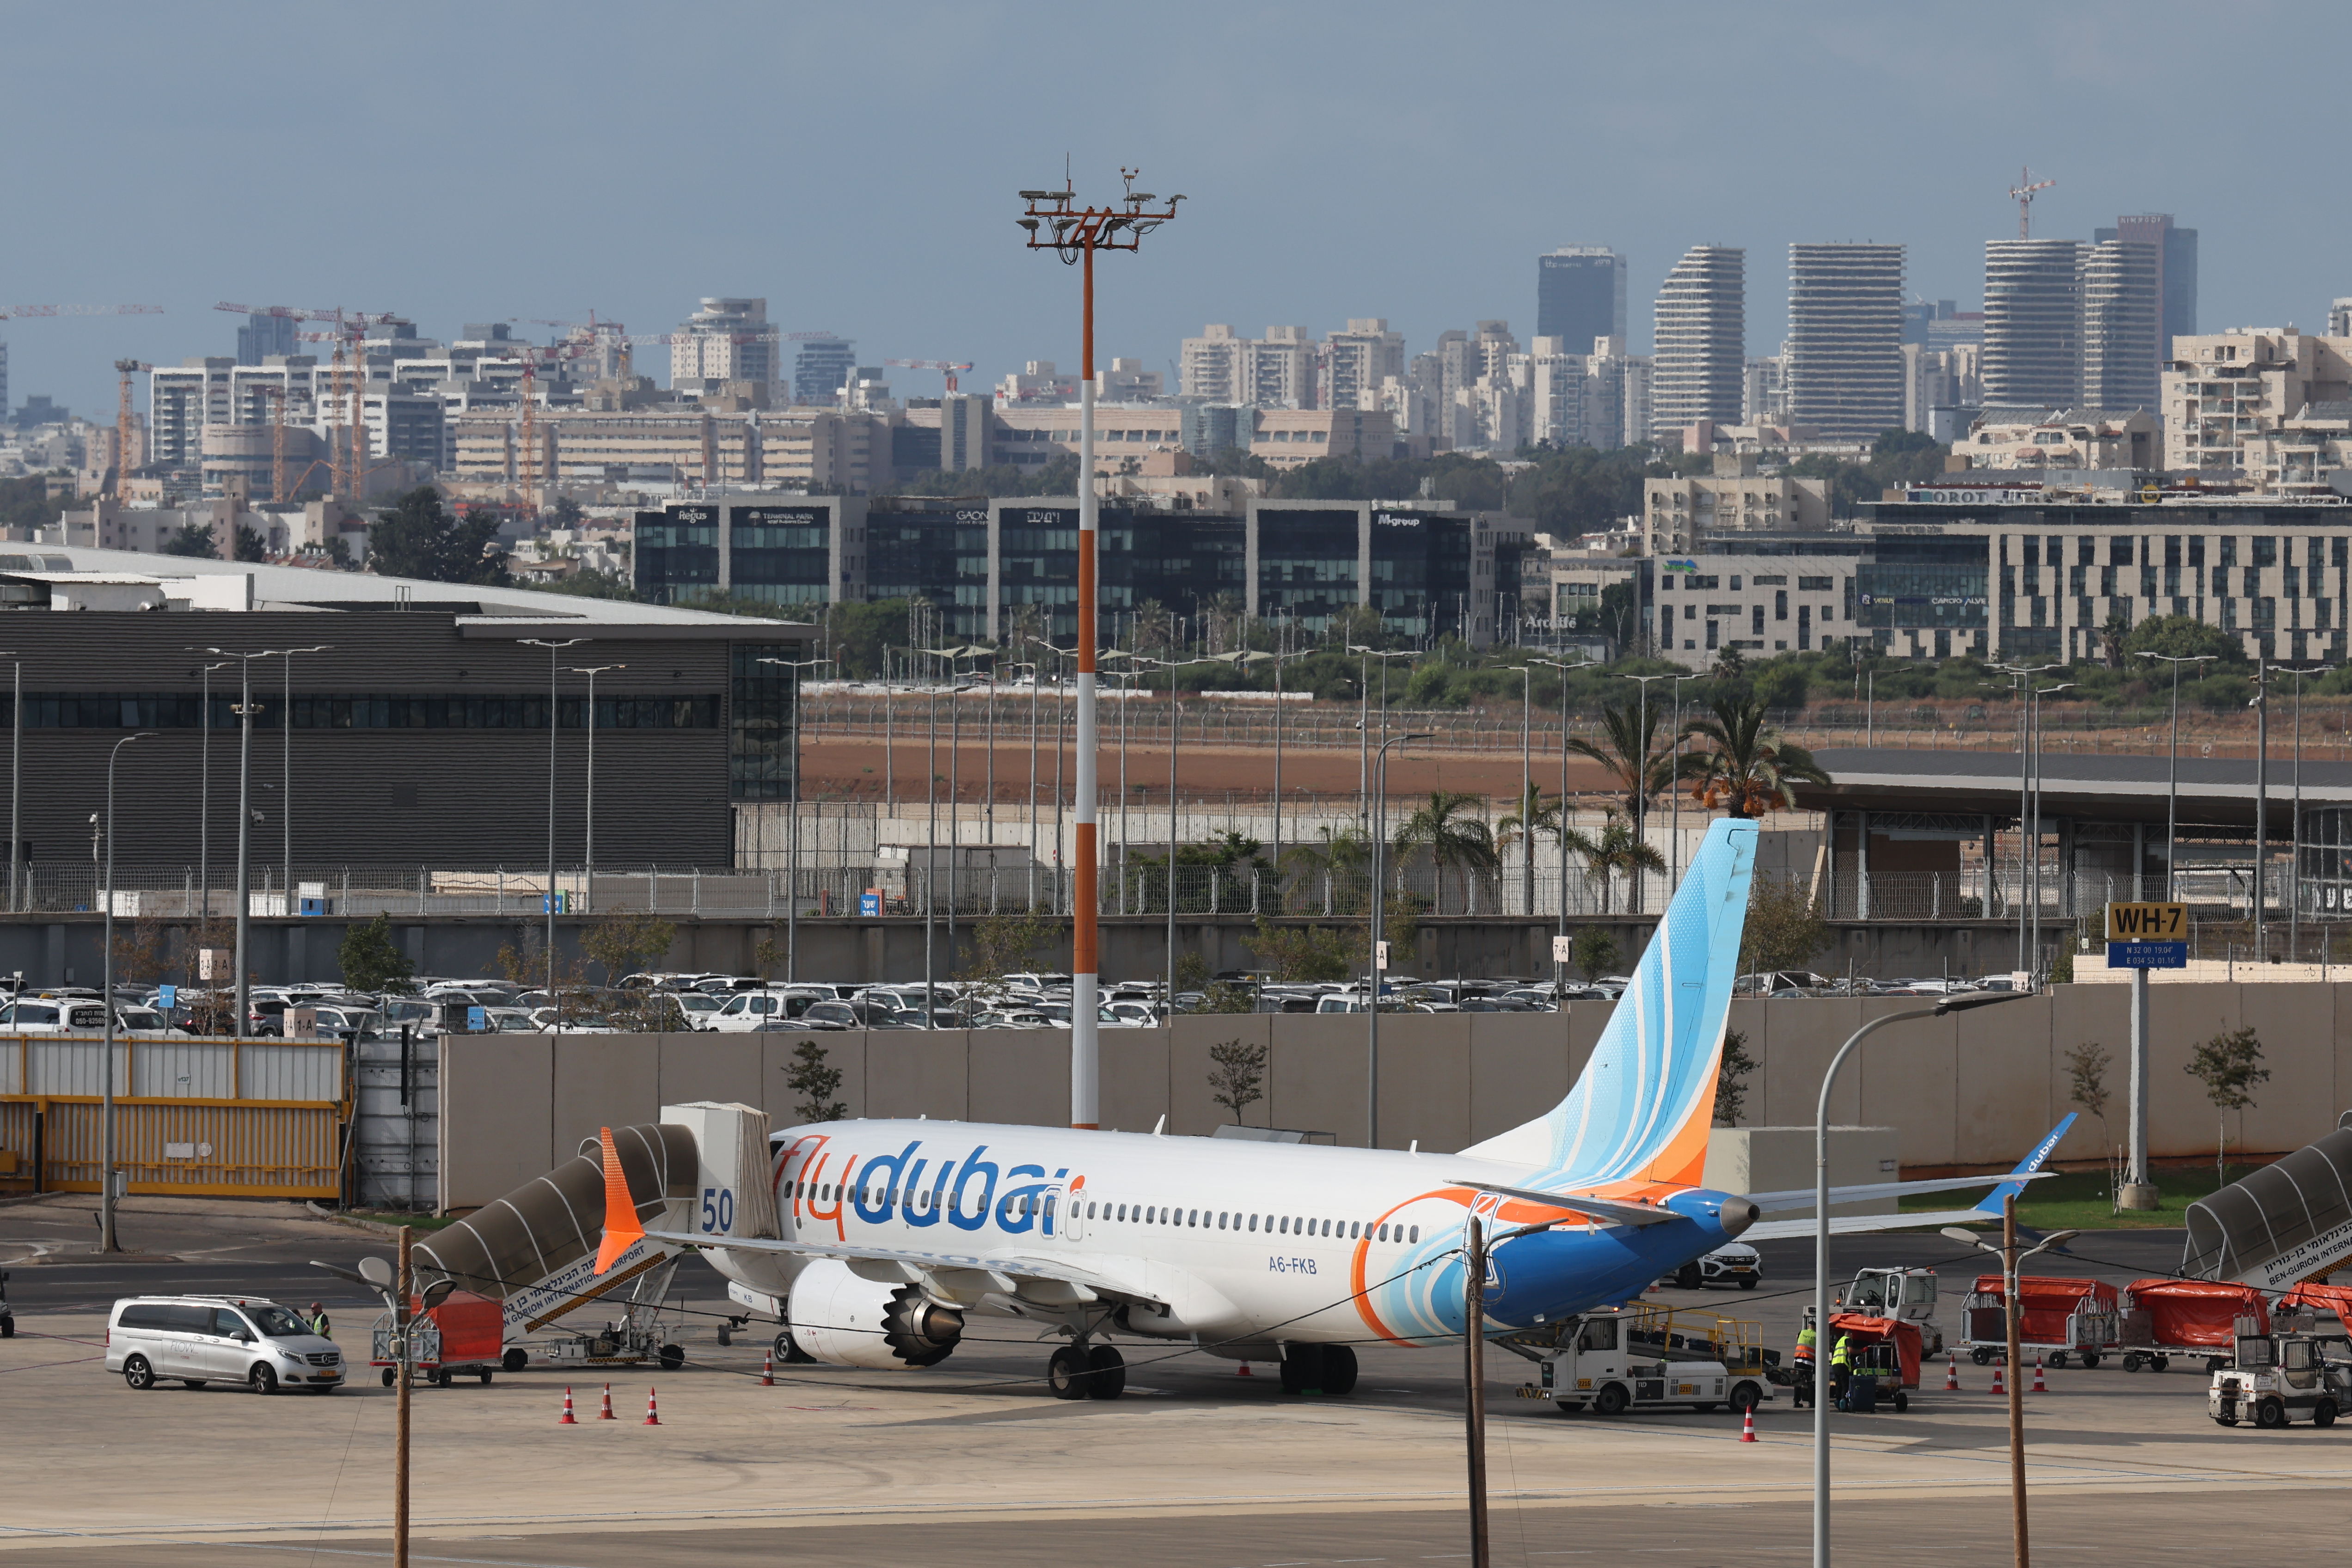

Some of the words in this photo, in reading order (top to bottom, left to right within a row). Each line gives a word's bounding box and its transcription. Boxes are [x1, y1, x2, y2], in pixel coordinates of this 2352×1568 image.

[1933, 491, 1986, 503] OROT
[679, 510, 707, 524] Regus
[956, 511, 989, 520] GAON
[863, 900, 876, 909] שער
[2115, 908, 2181, 933] WH-7
[1376, 950, 1384, 960] -A
[1554, 944, 1567, 955] 7-A
[201, 959, 210, 970] 3-A
[214, 959, 228, 971] 3-A
[297, 1019, 312, 1031] 1-A
[773, 1134, 1085, 1242] flydubai
[702, 1188, 733, 1232] 50
[1269, 1256, 1317, 1275] A6-FKB
[2264, 1247, 2306, 1274] בן-גוריון
[2269, 1254, 2320, 1286] BEN-GURION
[511, 1300, 544, 1323] GURION
[611, 1245, 644, 1270] AIRPORT
[516, 1295, 528, 1309] בן
[743, 1293, 753, 1303] KB
[171, 1341, 196, 1353] FLOW
